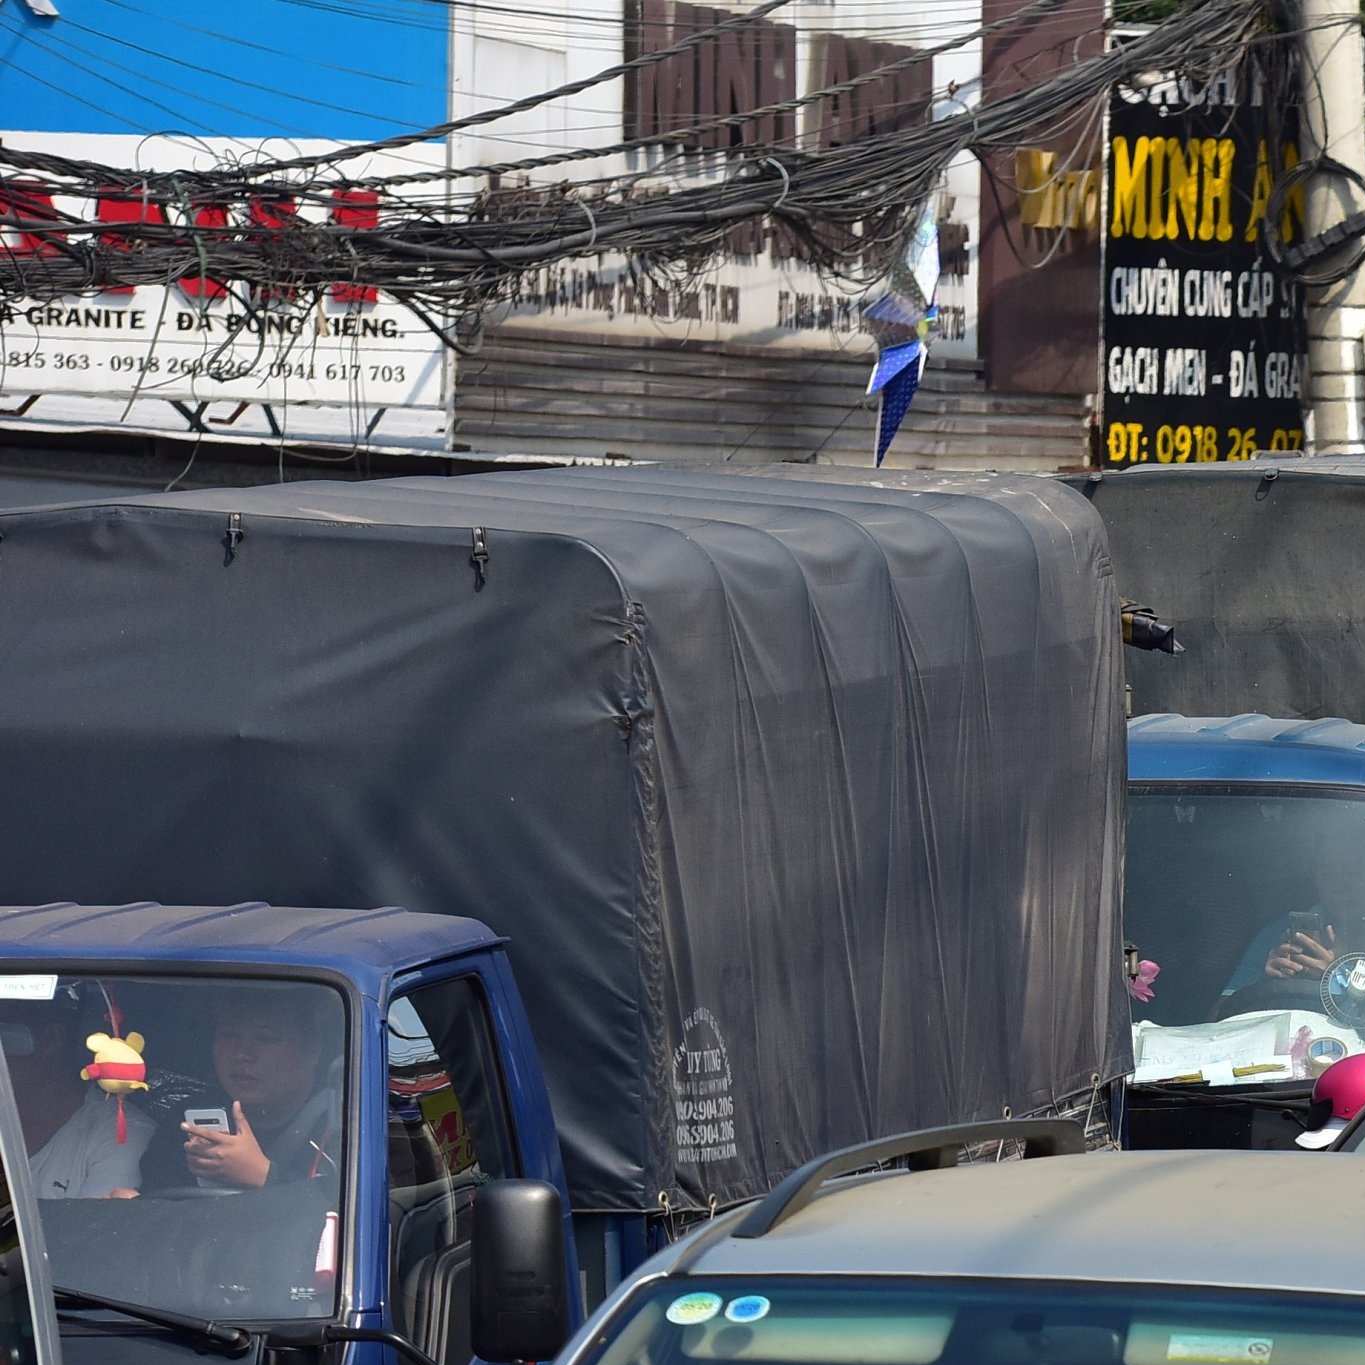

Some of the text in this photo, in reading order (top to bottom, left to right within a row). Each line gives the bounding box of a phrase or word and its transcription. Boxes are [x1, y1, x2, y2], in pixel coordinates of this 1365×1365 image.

[1111, 135, 1236, 242] MINH
[1110, 257, 1180, 318] CHUYÊN
[1183, 268, 1233, 319] CUNG
[1237, 256, 1274, 319] CẤP
[27, 307, 146, 330] GRANITE
[8, 351, 46, 369] 815
[54, 353, 90, 371] 363
[110, 355, 160, 374] 0918
[326, 363, 361, 381] 617
[369, 366, 406, 383] 703
[1108, 346, 1159, 404] GẠCH
[1163, 347, 1206, 397] MEN
[1229, 340, 1259, 398] ĐÁ
[1265, 352, 1306, 399] GRA
[1107, 422, 1149, 463] ĐT:
[1156, 424, 1219, 464] 0918
